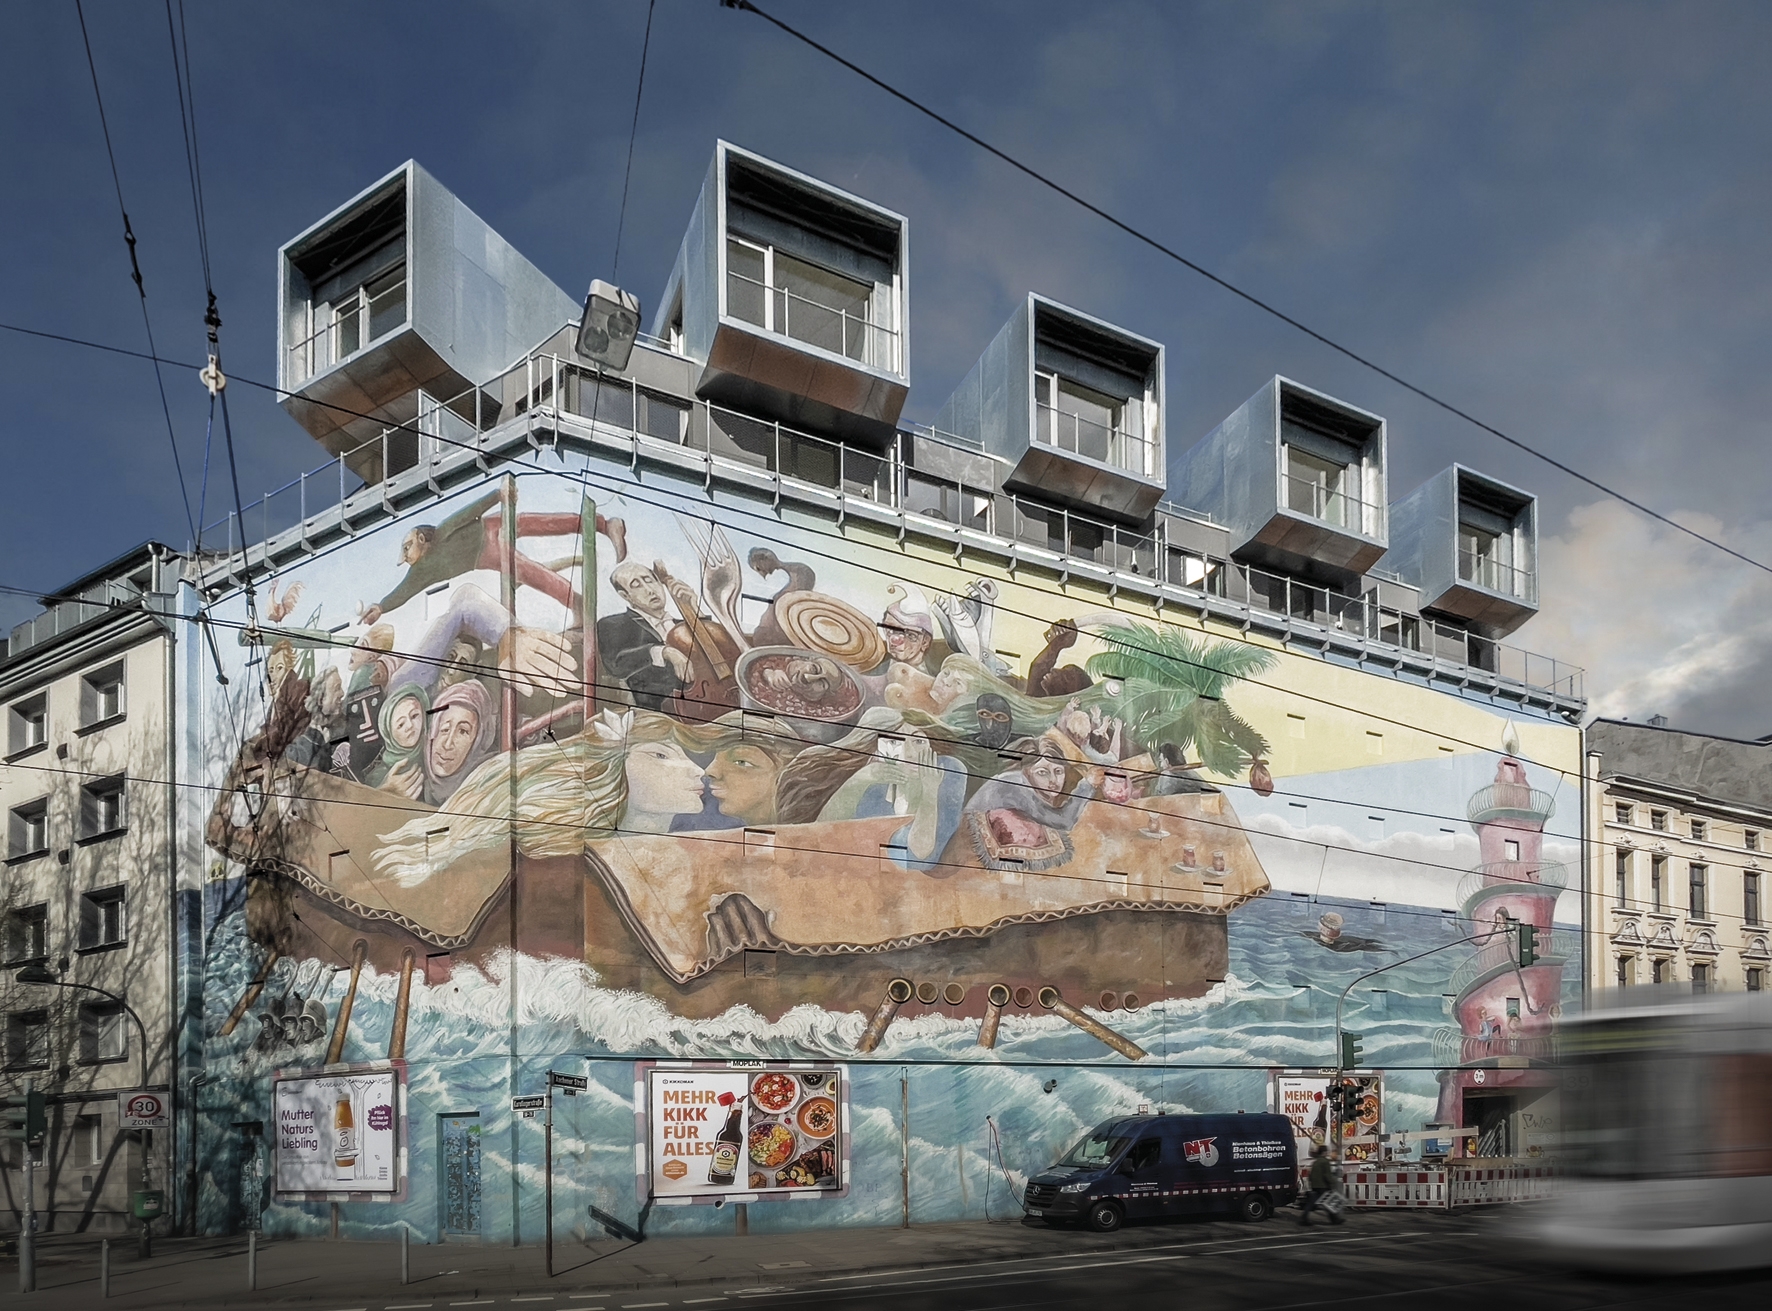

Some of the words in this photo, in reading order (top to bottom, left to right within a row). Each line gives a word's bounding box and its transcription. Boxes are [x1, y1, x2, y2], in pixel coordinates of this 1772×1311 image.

[1567, 1076, 1589, 1088] 39
[663, 1090, 717, 1104] MEHR
[1284, 1090, 1313, 1101] MEHR
[135, 1101, 155, 1112] 30
[1284, 1103, 1309, 1113] KIKK
[281, 1109, 315, 1121] Mutter
[663, 1107, 708, 1121] KIKK
[281, 1124, 314, 1135] Naturs
[663, 1122, 699, 1139] FÜR
[281, 1138, 318, 1151] Liebling
[663, 1141, 715, 1157] ALLES
[1182, 1136, 1218, 1158] NT
[1232, 1145, 1286, 1153] Betonbohren
